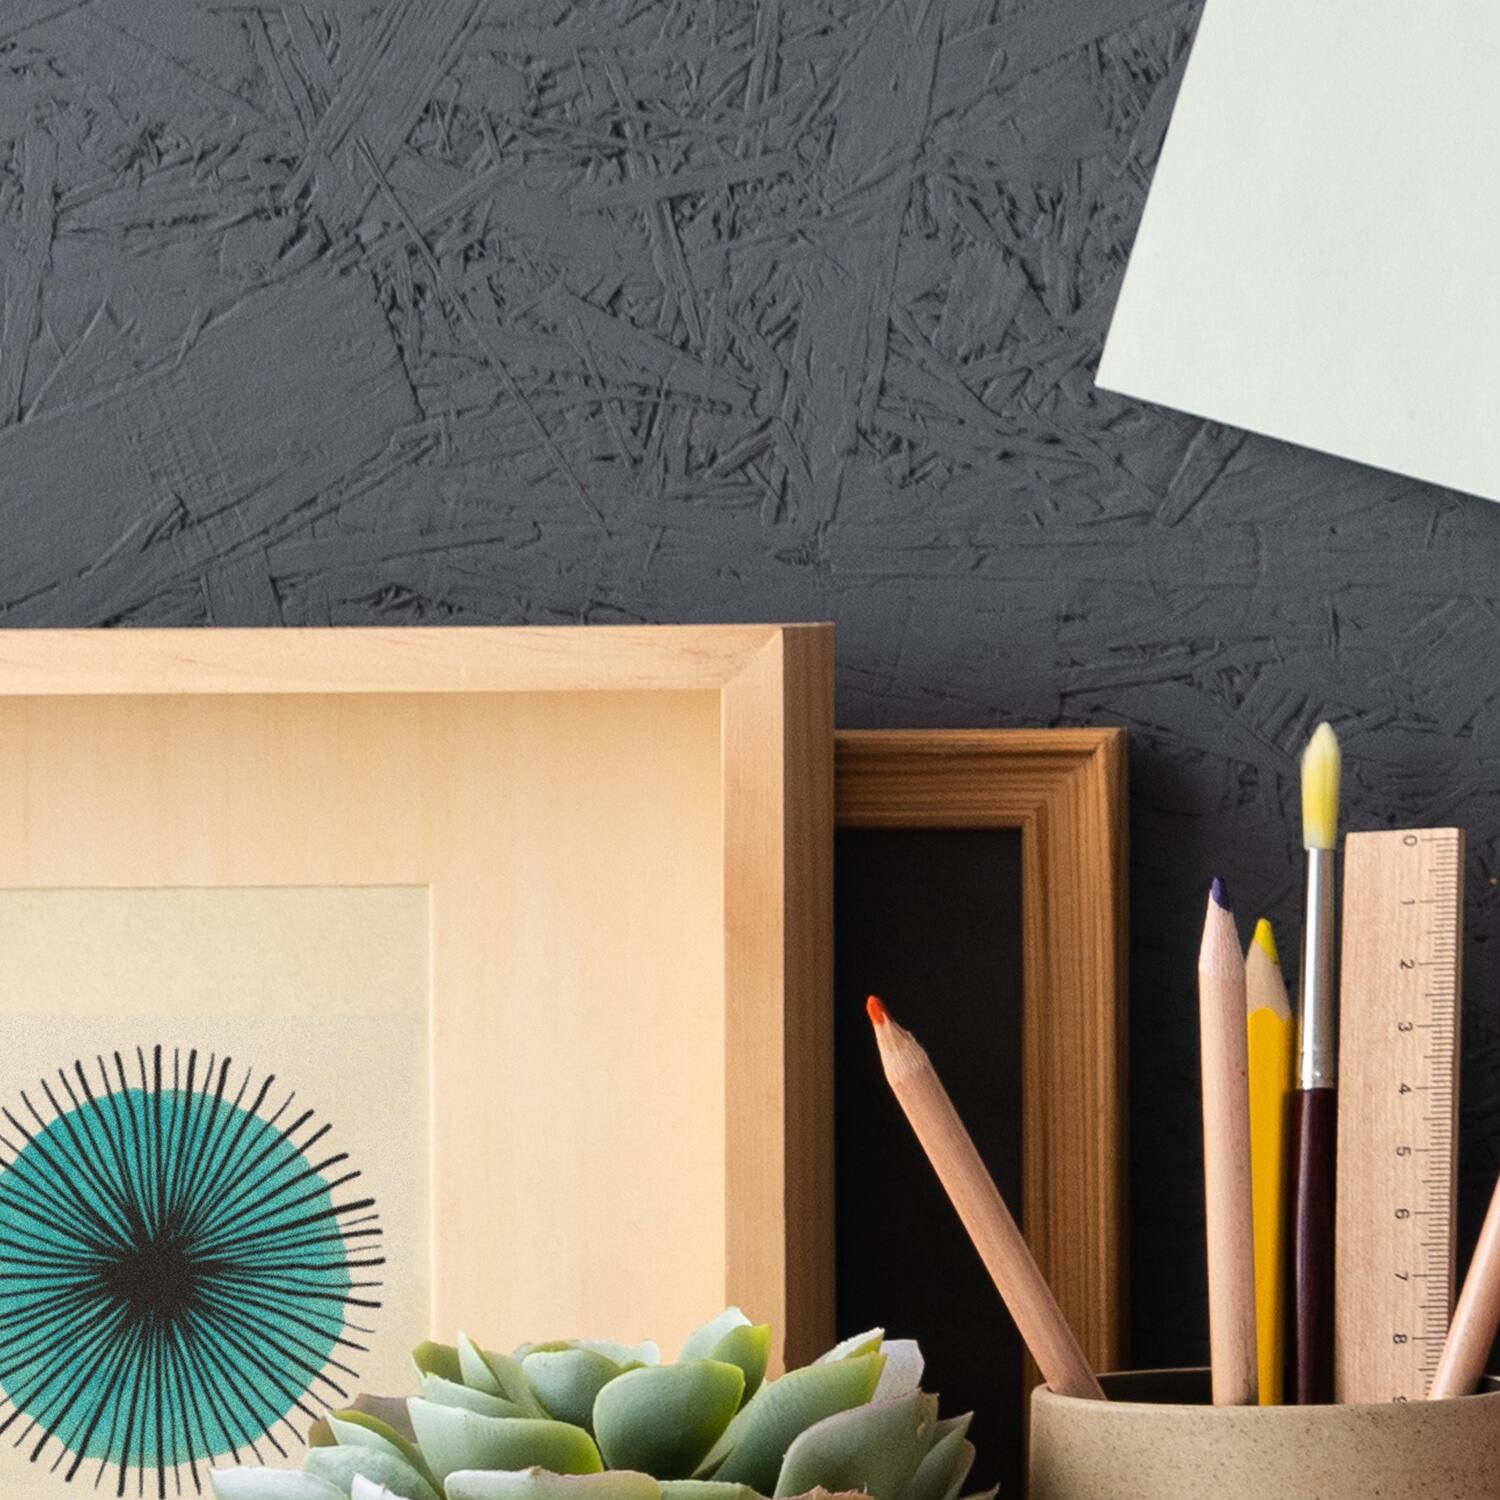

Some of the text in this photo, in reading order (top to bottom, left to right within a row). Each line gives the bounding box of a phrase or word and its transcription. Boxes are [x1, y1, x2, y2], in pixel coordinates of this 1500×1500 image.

[1400, 959, 1415, 970] 2
[1398, 1021, 1413, 1032] 3
[1398, 1083, 1412, 1095] 4
[1396, 1146, 1411, 1157] 5
[1394, 1208, 1410, 1220] 6
[1394, 1271, 1409, 1281] 7
[1392, 1333, 1408, 1345] 8
